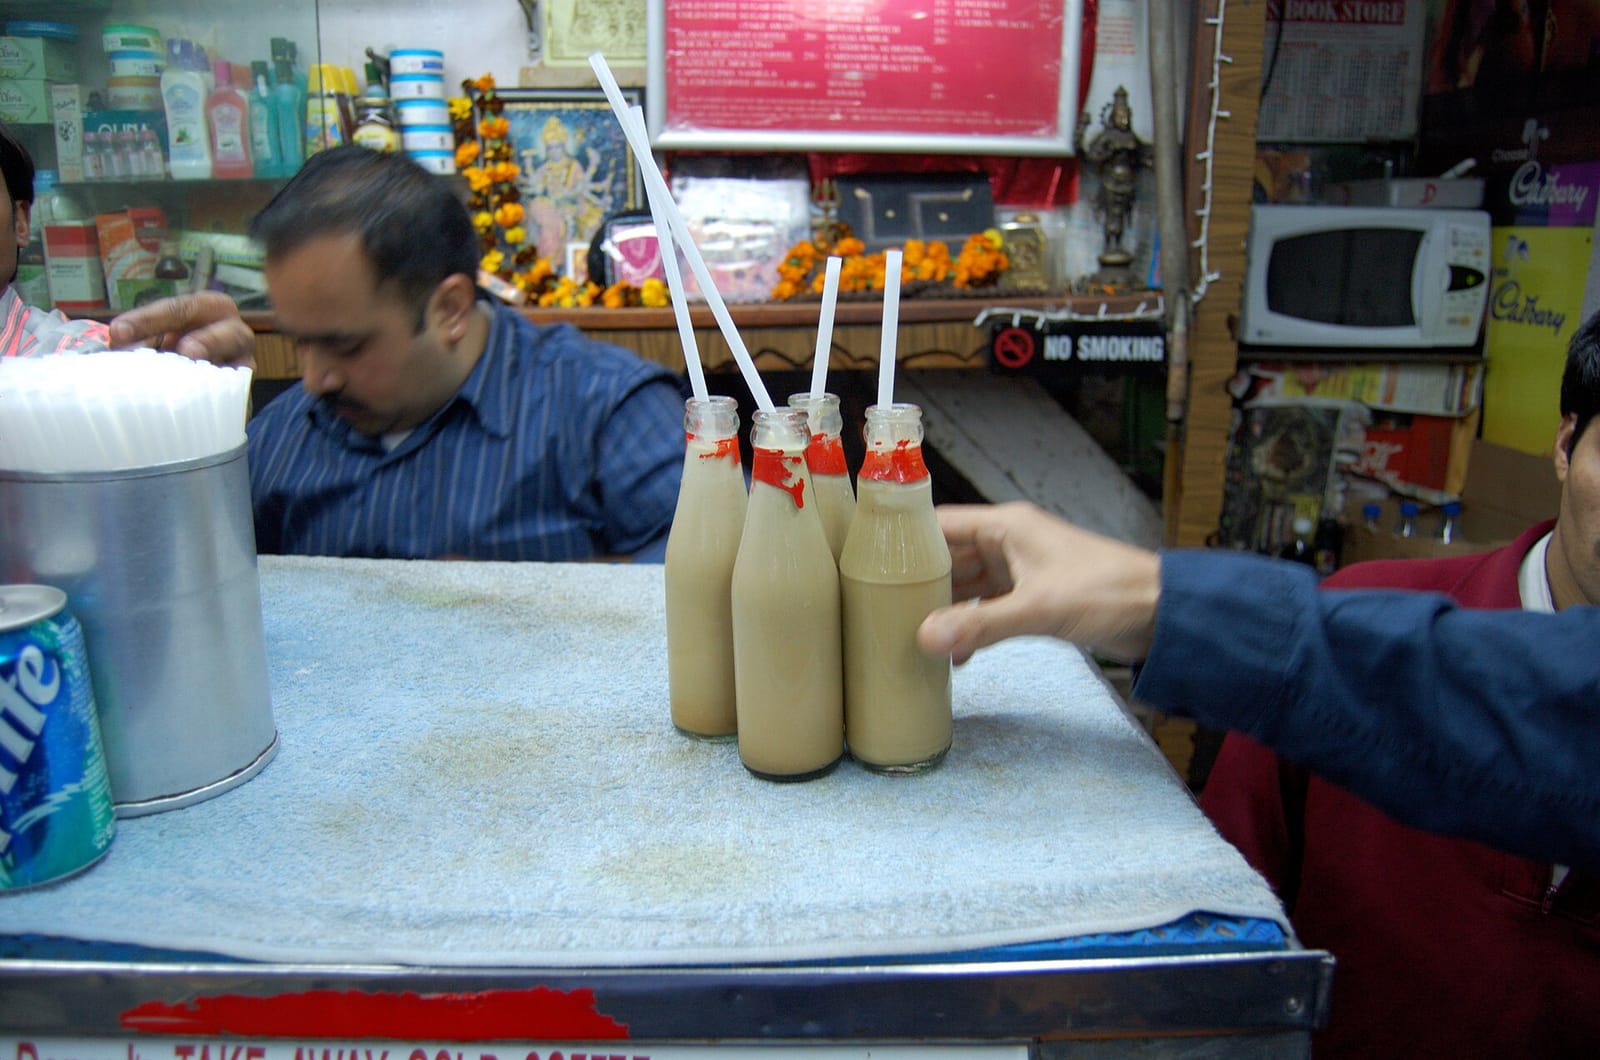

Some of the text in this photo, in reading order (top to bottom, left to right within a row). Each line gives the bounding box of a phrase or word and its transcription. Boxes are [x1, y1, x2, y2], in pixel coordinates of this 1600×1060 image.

[1285, 0, 1338, 20] BOOK
[1341, 1, 1403, 22] STORE
[1509, 160, 1589, 213] Cadbury
[1491, 280, 1566, 336] Cadbury
[1044, 335, 1165, 362] NO SMOKING
